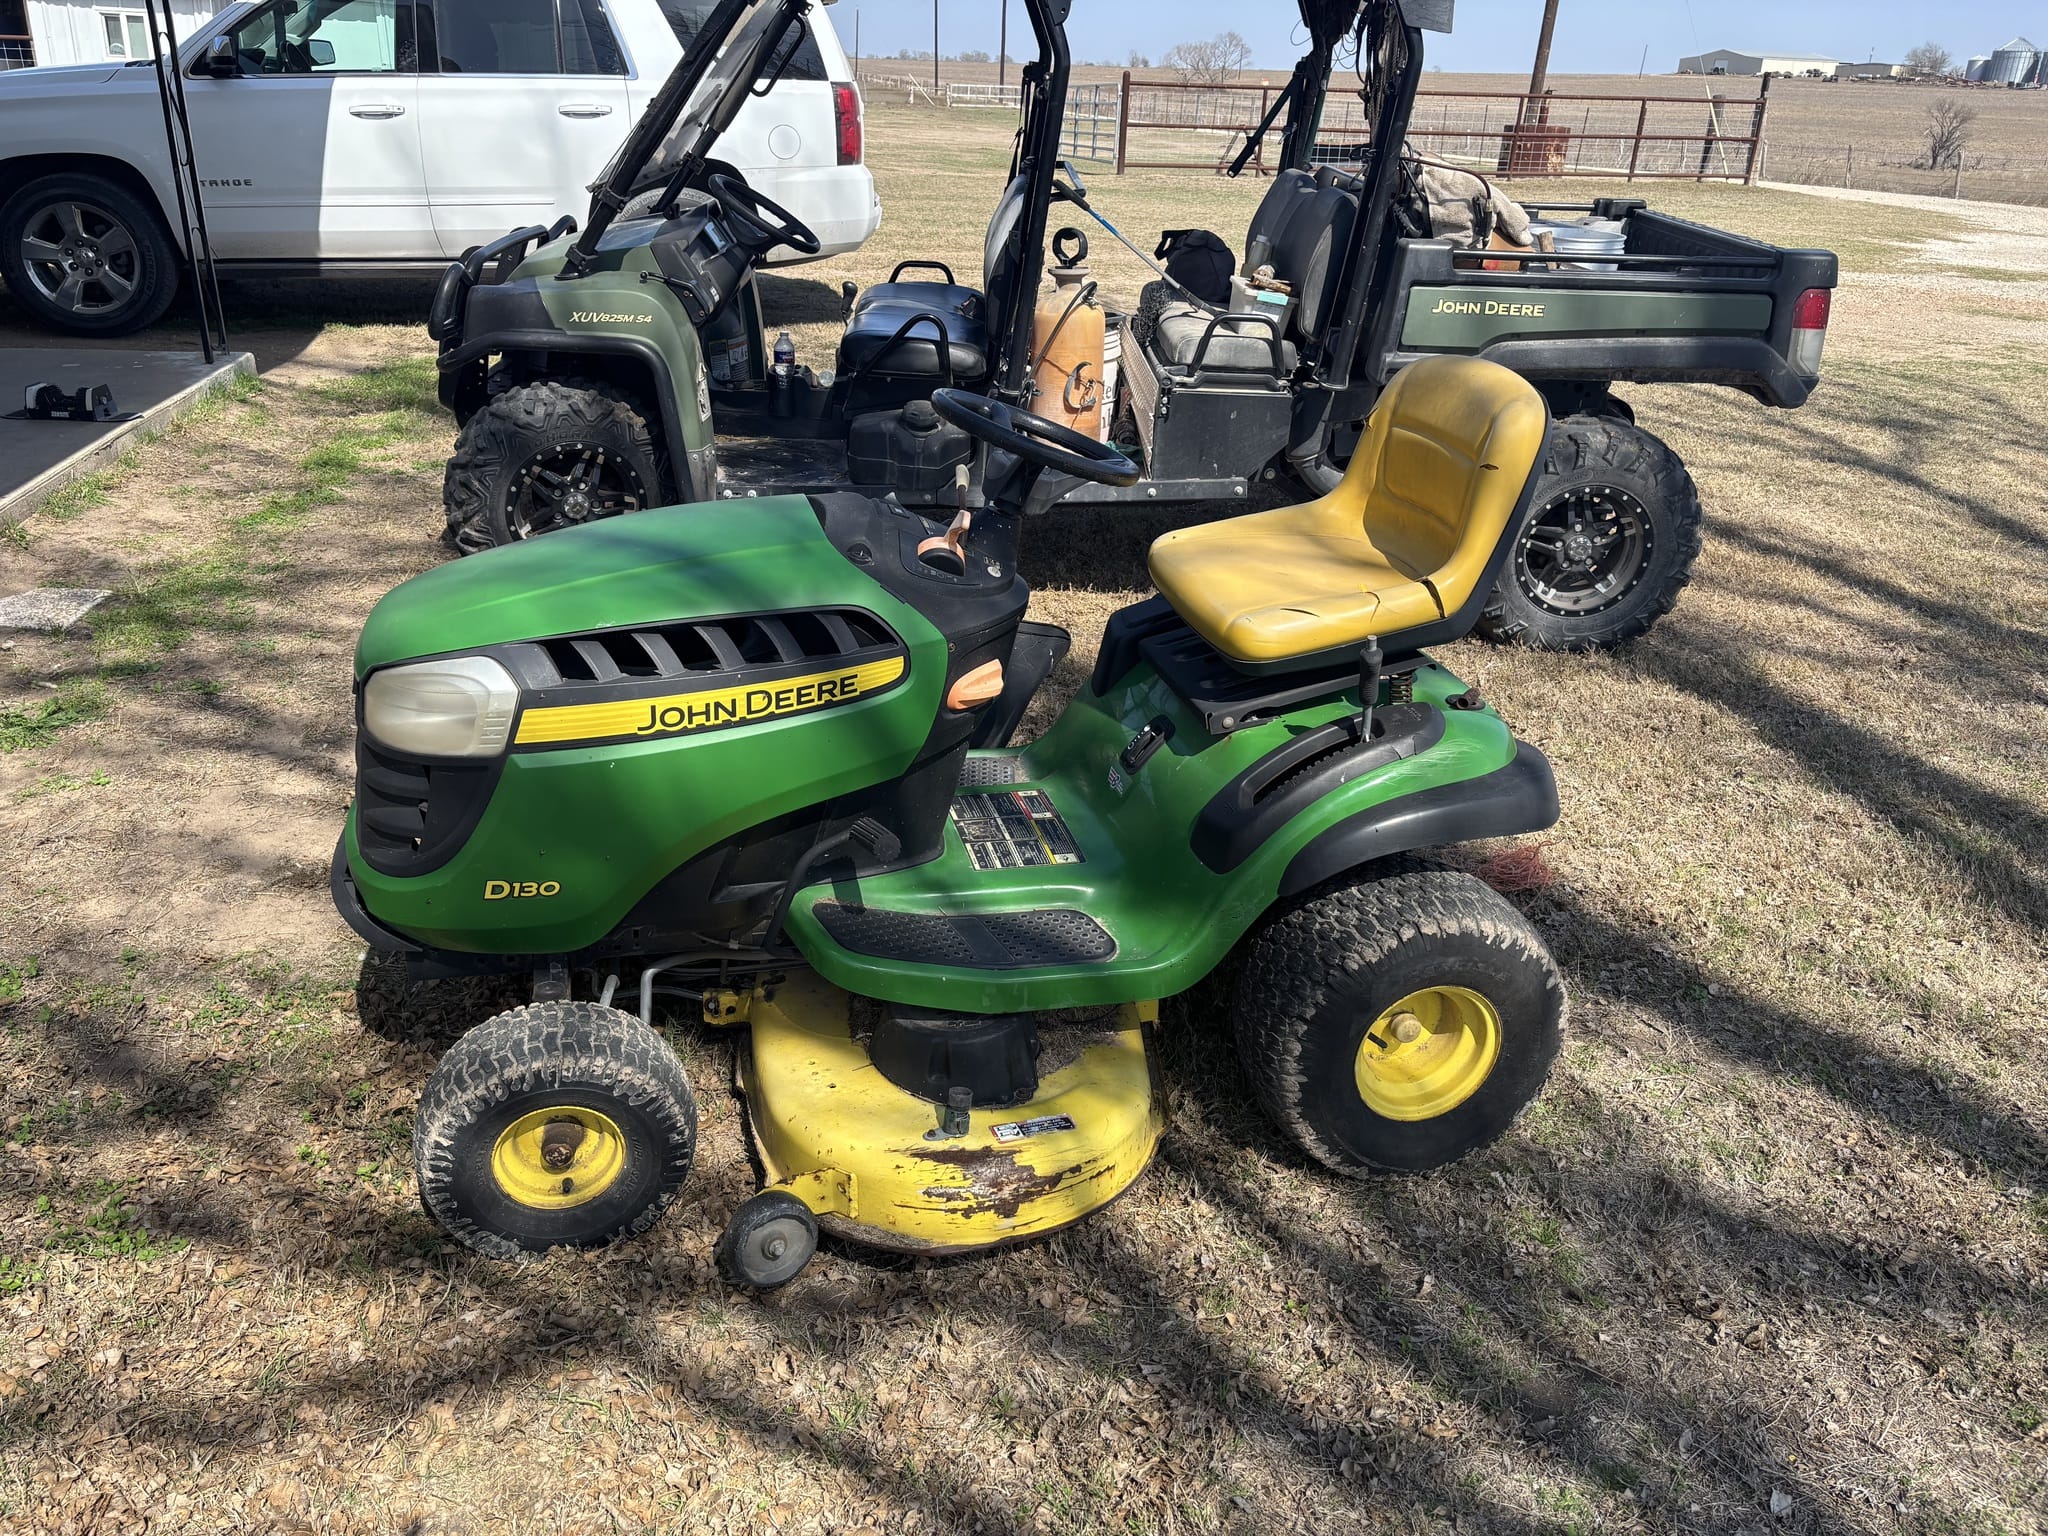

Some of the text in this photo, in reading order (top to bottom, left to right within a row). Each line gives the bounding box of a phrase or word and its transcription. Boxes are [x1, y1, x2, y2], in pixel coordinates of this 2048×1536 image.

[199, 178, 253, 188] TAHOE
[568, 311, 653, 324] XUV825M S4
[1432, 298, 1546, 318] JOHN DEERE
[637, 674, 859, 732] JOHN DEERE
[484, 880, 561, 900] D130
